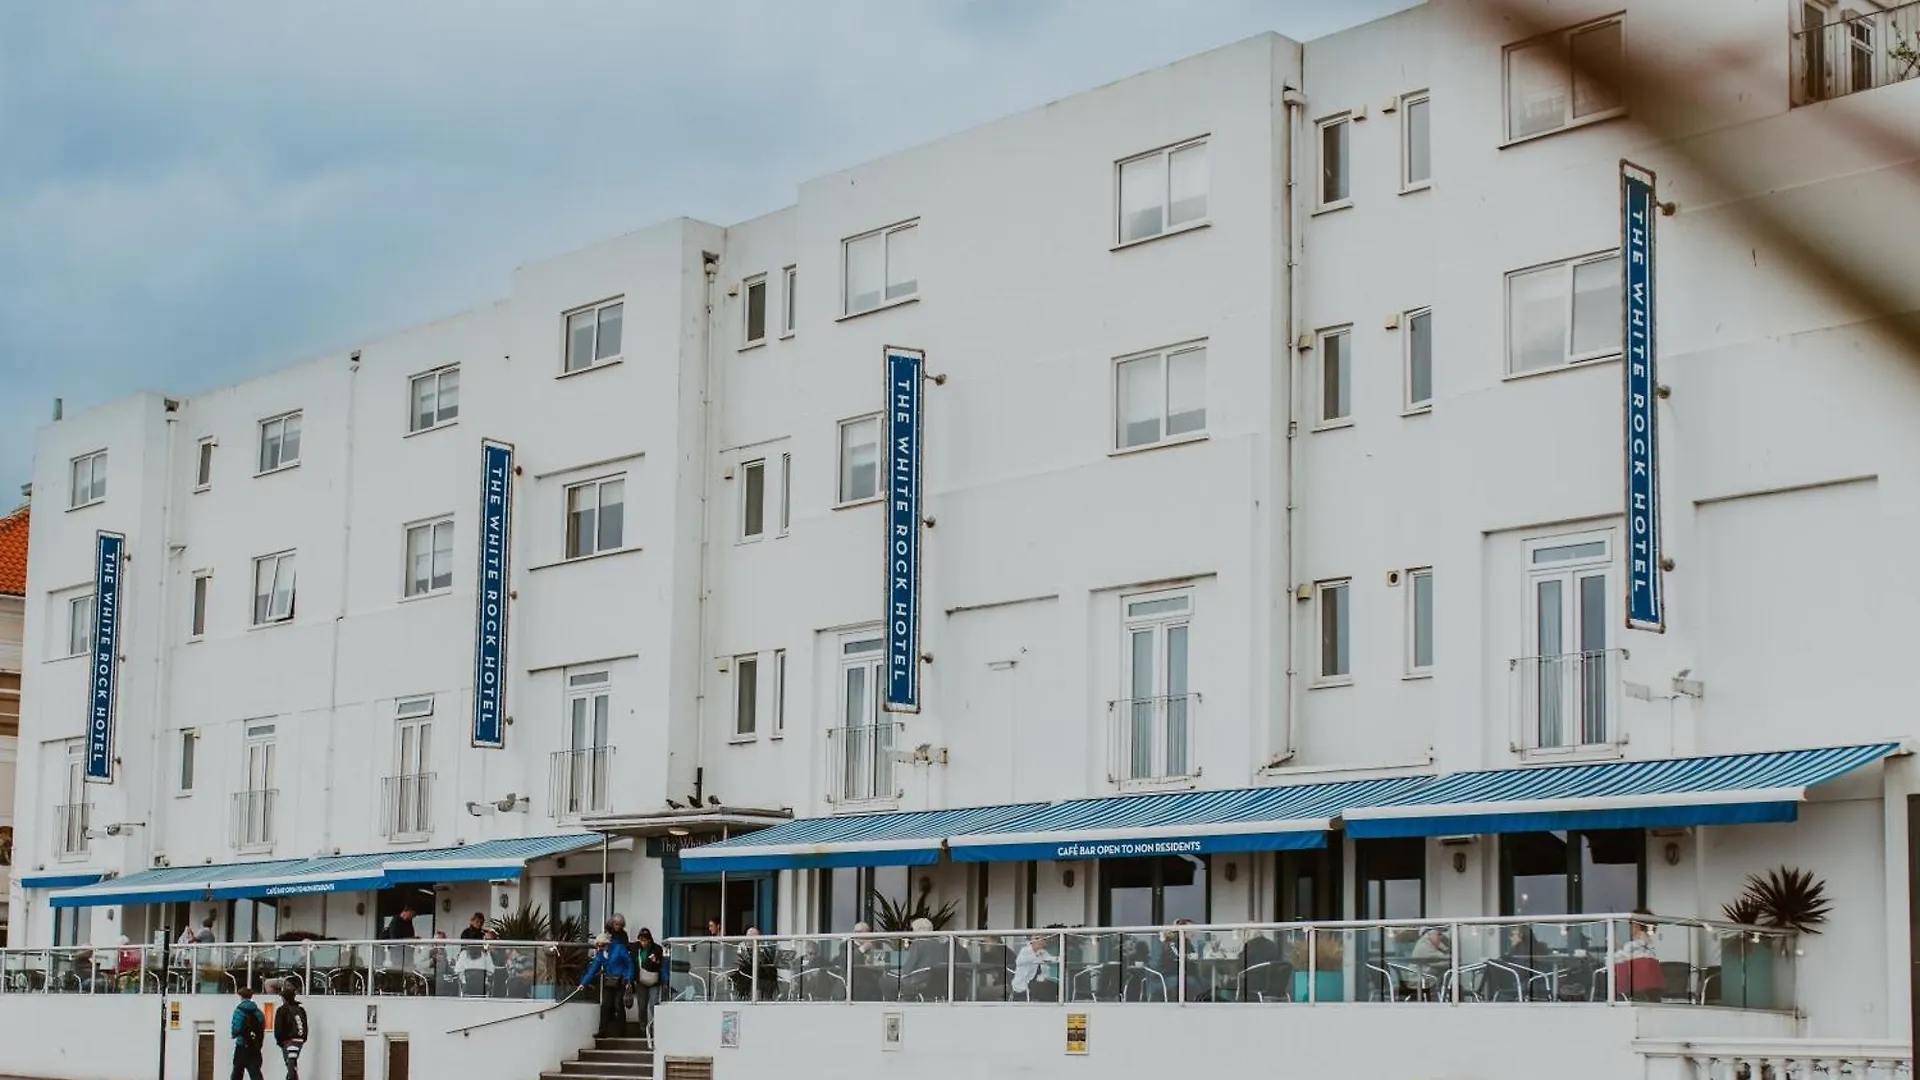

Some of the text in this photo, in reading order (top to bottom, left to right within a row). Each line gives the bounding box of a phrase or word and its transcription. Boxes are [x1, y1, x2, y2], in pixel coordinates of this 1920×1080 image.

[1632, 210, 1646, 592] THE WHITE ROCK HOTEL
[93, 552, 115, 762] THE WHITE ROCK HOTEL
[482, 466, 503, 723] THE WHITE ROCK HOTEL
[894, 379, 910, 681] THE WHITE ROCK HOTEL
[1057, 841, 1201, 856] CAFÉ BAR OPEN TO NON RESIDENTS
